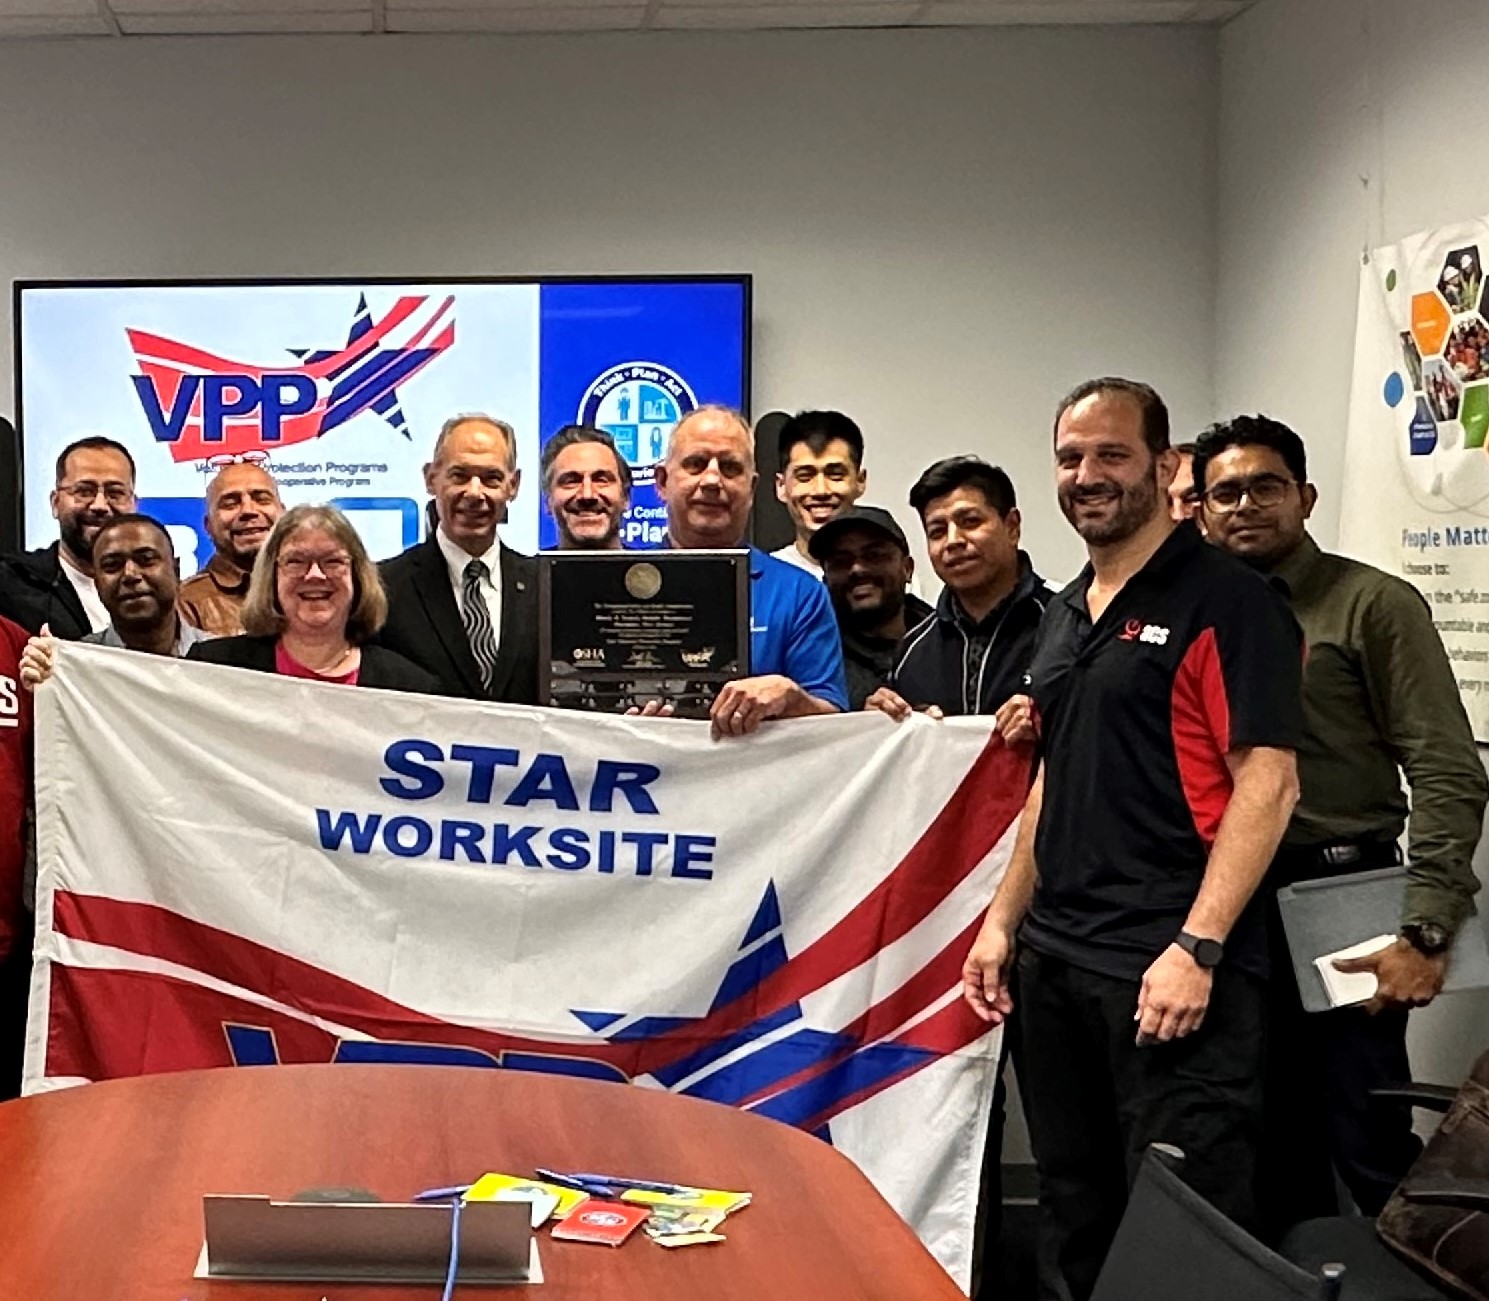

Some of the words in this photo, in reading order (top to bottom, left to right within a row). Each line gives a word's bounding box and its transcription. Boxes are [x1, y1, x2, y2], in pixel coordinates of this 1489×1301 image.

[593, 372, 625, 397] Think
[631, 367, 659, 381] Plan
[664, 378, 683, 396] Act
[130, 375, 318, 442] VPP
[277, 477, 327, 487] ooperative
[330, 477, 371, 488] Program
[326, 462, 389, 476] Programs
[1402, 526, 1441, 553] People
[1445, 526, 1489, 546] Matt
[379, 738, 661, 816] STAR
[315, 808, 717, 880] WORKSITE
